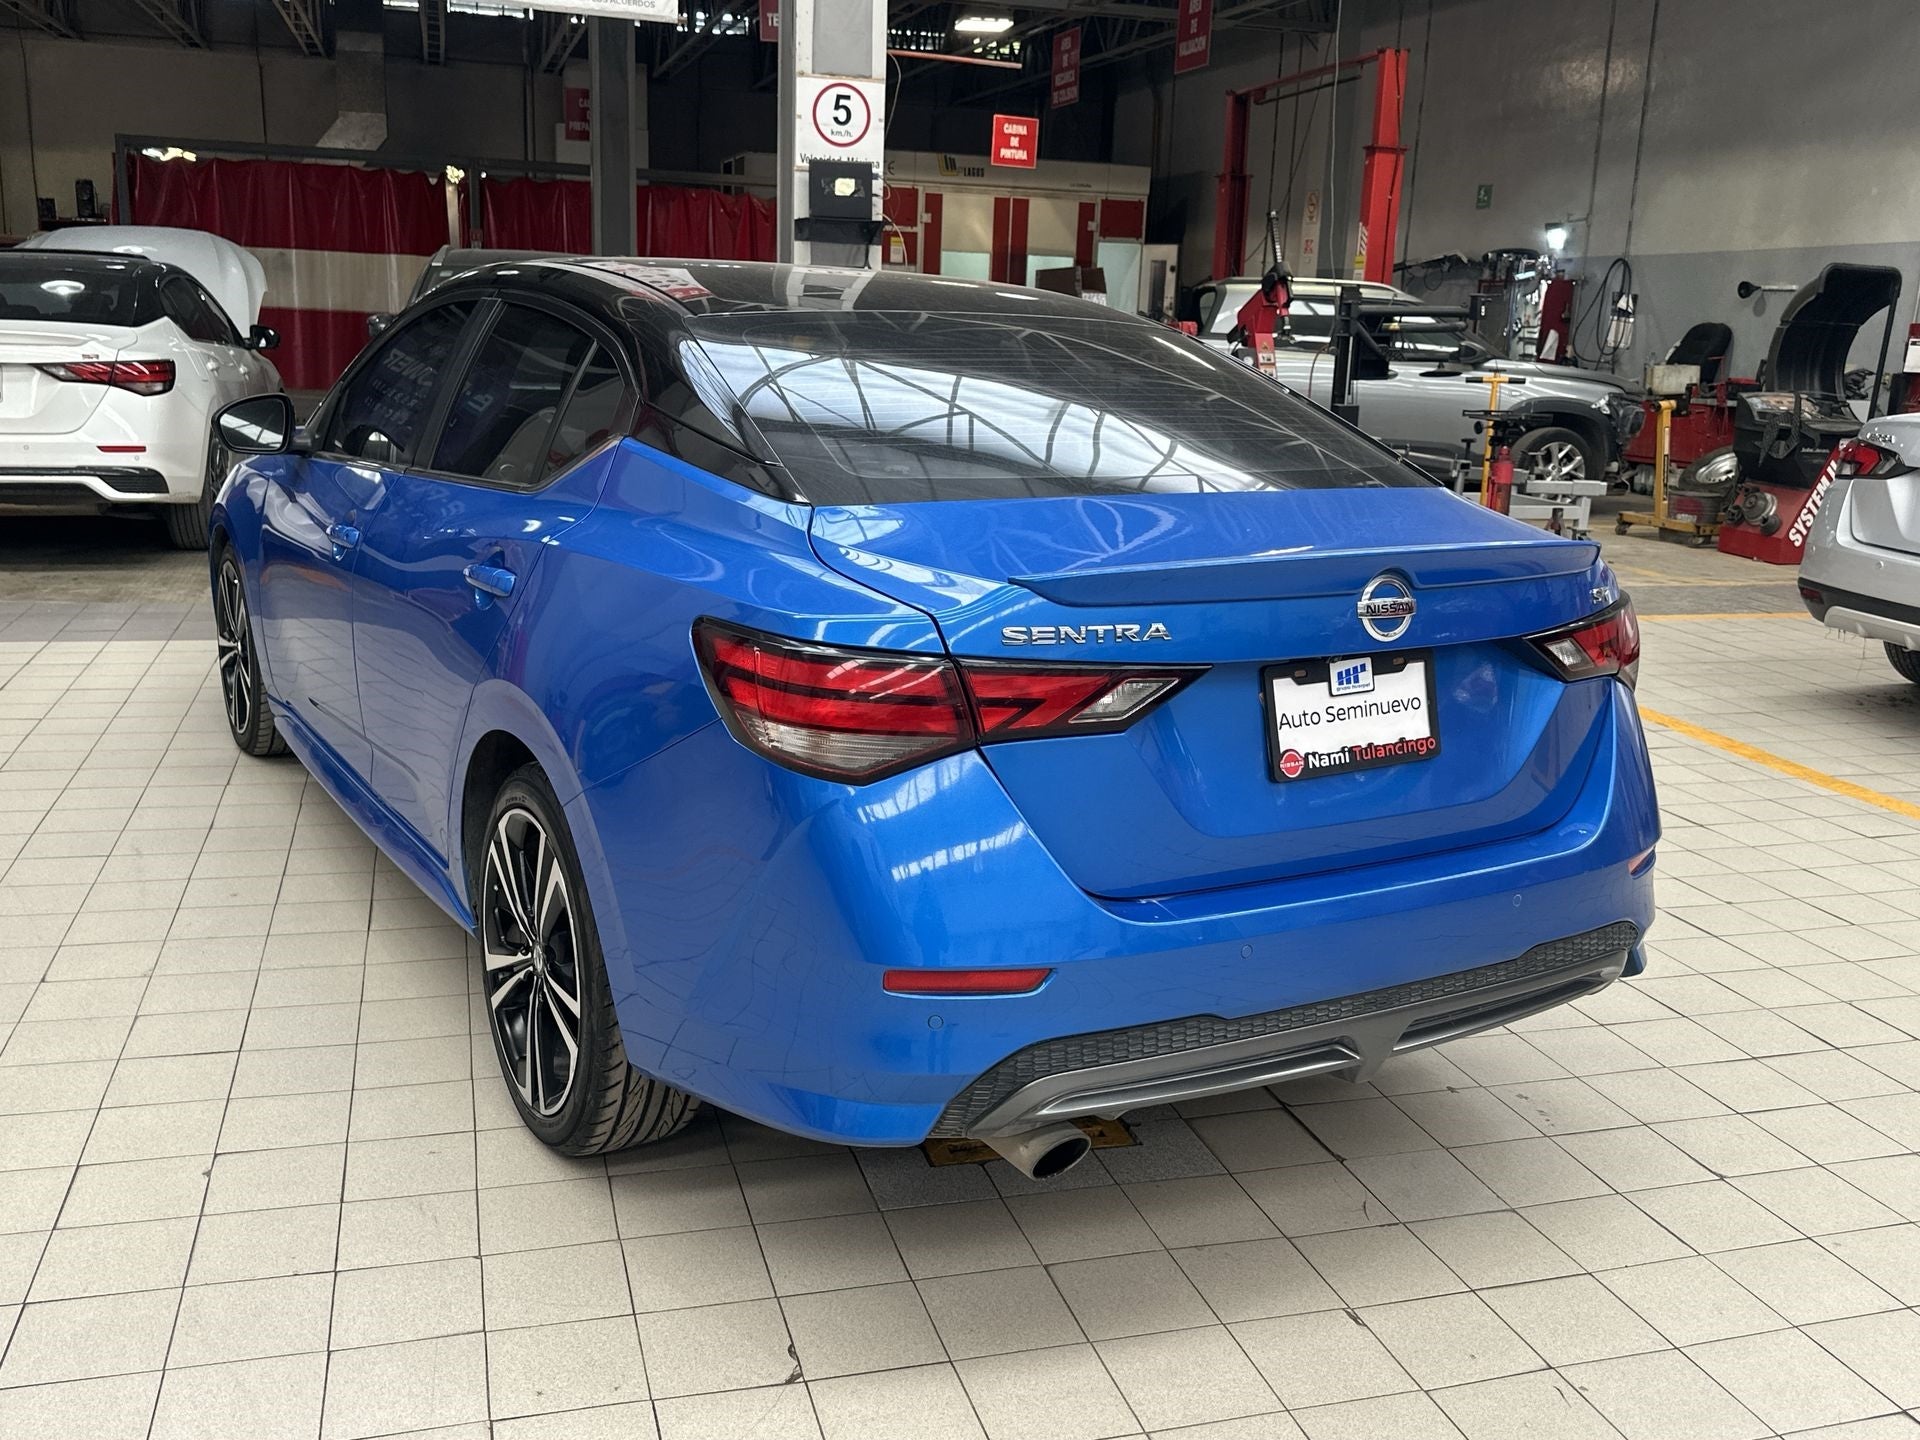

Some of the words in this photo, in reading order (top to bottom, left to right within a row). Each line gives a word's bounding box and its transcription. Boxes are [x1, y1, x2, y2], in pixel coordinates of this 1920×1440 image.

[832, 93, 852, 126] 5
[1788, 475, 1832, 548] SYSTEM
[1366, 602, 1414, 614] NISSAN
[1001, 622, 1172, 646] SENTRA
[1279, 710, 1321, 731] Auto
[1326, 696, 1421, 723] Seminuevo
[1308, 746, 1350, 769] Nami
[1353, 736, 1436, 761] Tulancingo
